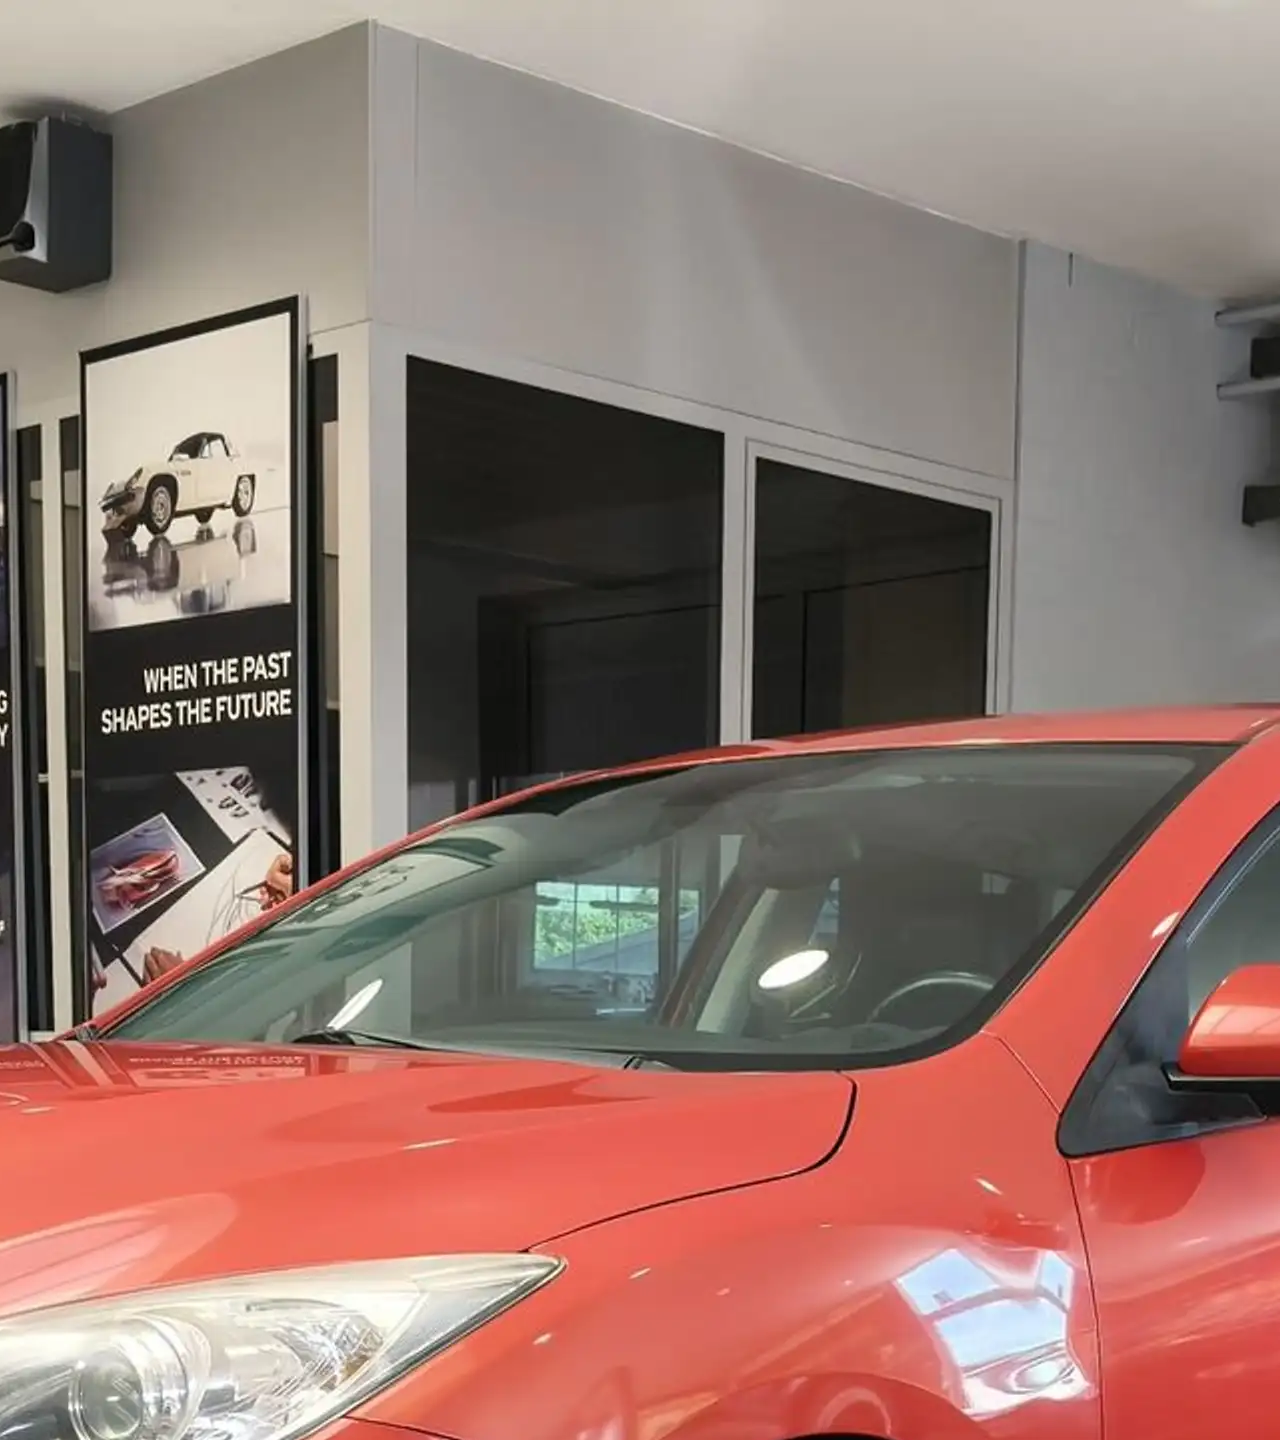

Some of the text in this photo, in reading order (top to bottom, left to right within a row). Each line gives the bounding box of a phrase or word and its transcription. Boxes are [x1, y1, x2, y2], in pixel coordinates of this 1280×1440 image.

[143, 650, 292, 694] WHEN THE PAST
[101, 688, 292, 734] SHAPES THE FUTURE
